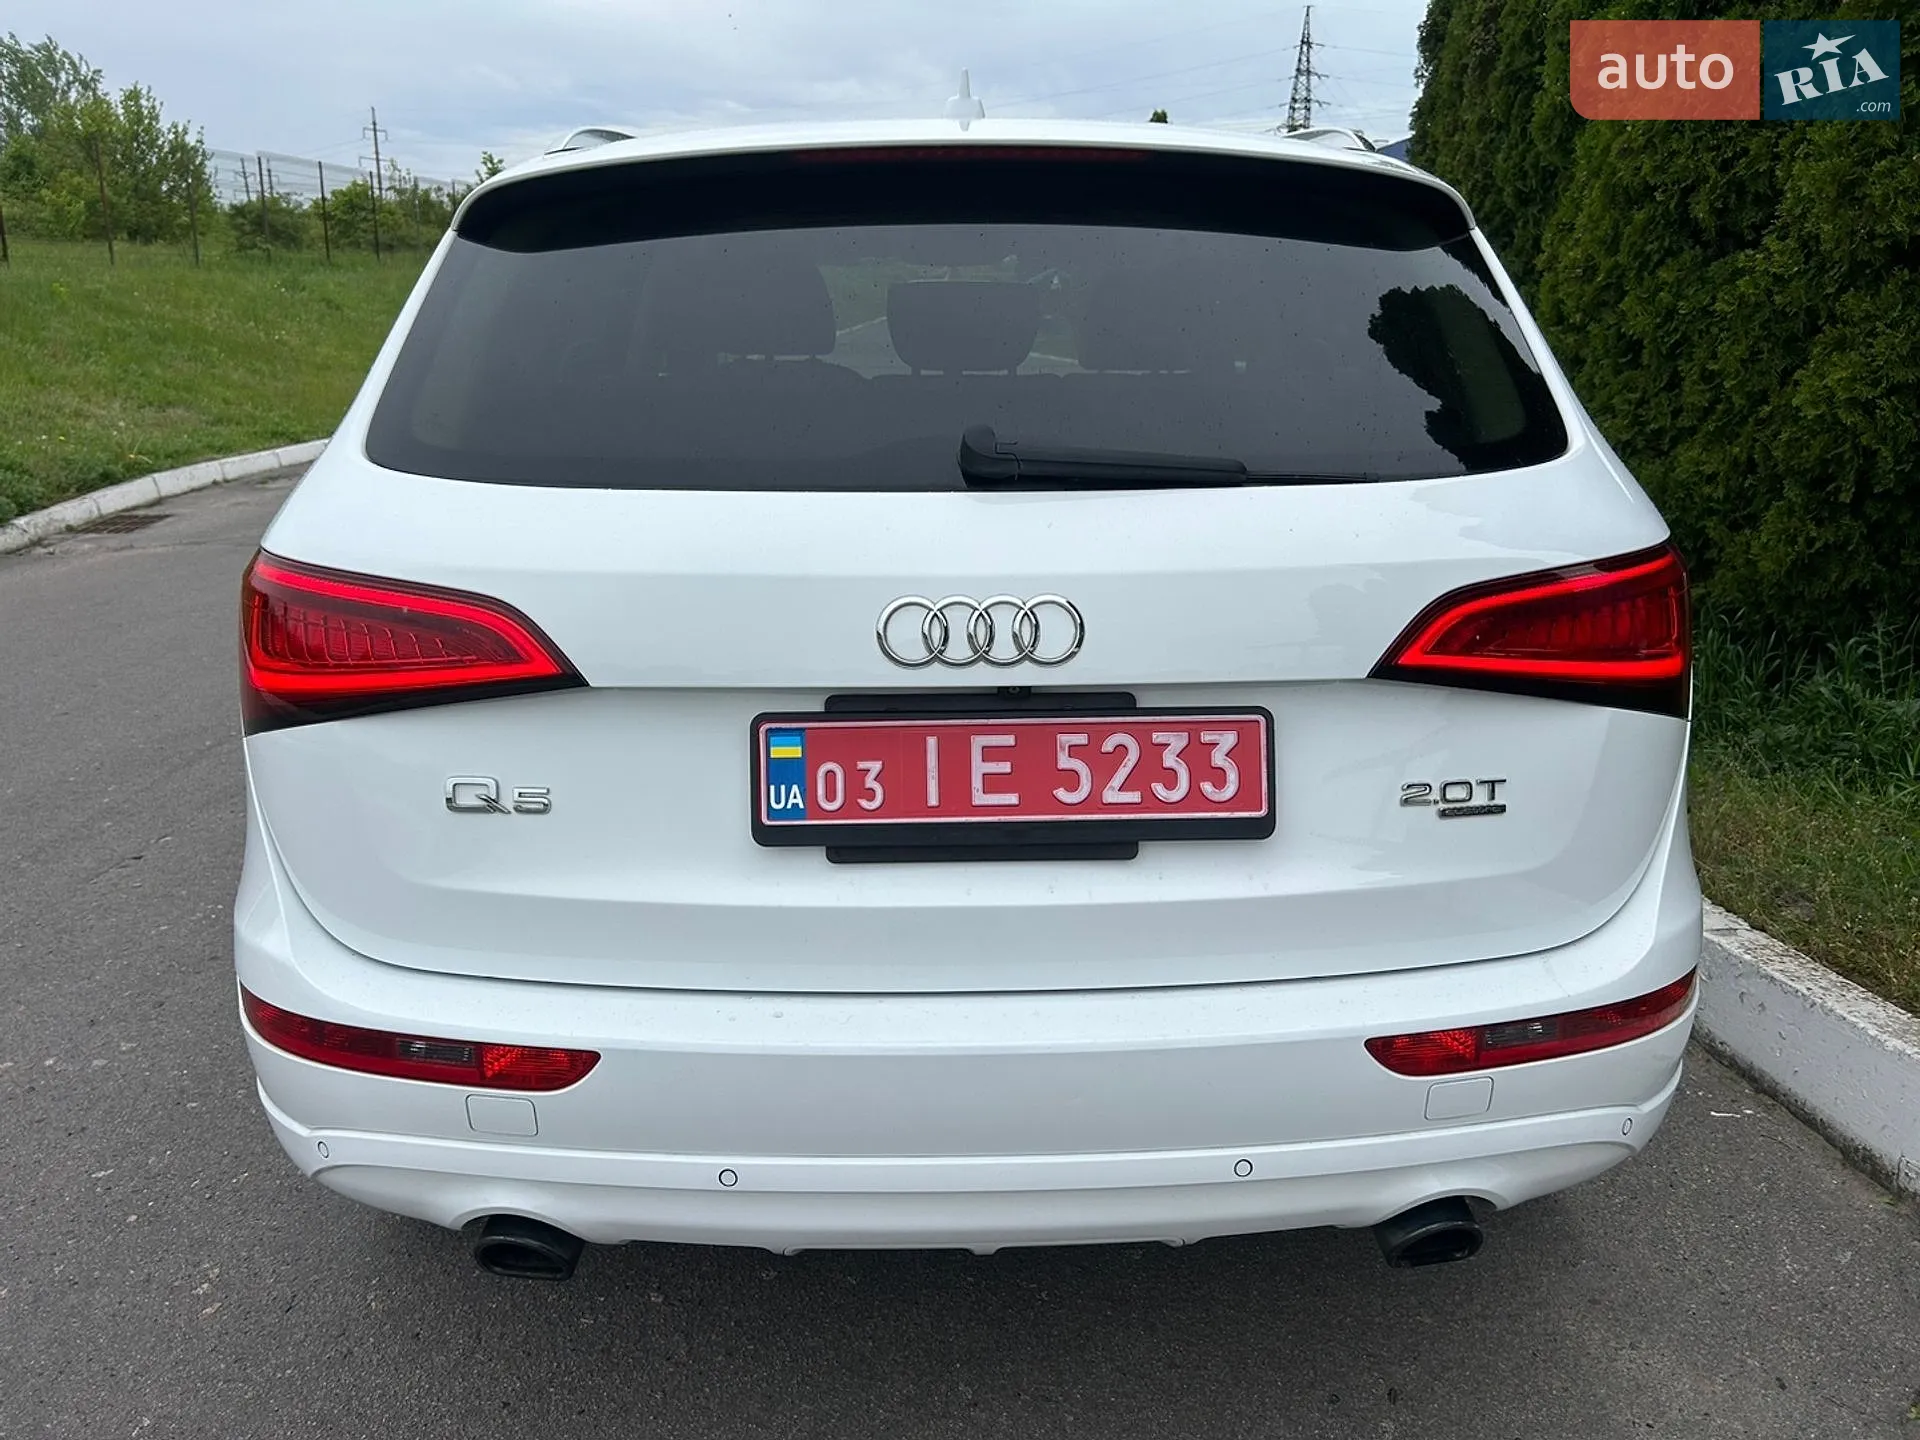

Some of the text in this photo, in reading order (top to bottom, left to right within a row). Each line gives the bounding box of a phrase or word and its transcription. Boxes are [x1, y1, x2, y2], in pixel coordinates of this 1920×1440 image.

[815, 730, 1241, 813] 03 IE 5233
[445, 775, 552, 815] Q5
[769, 783, 805, 810] UA
[1400, 779, 1507, 807] 2.0T
